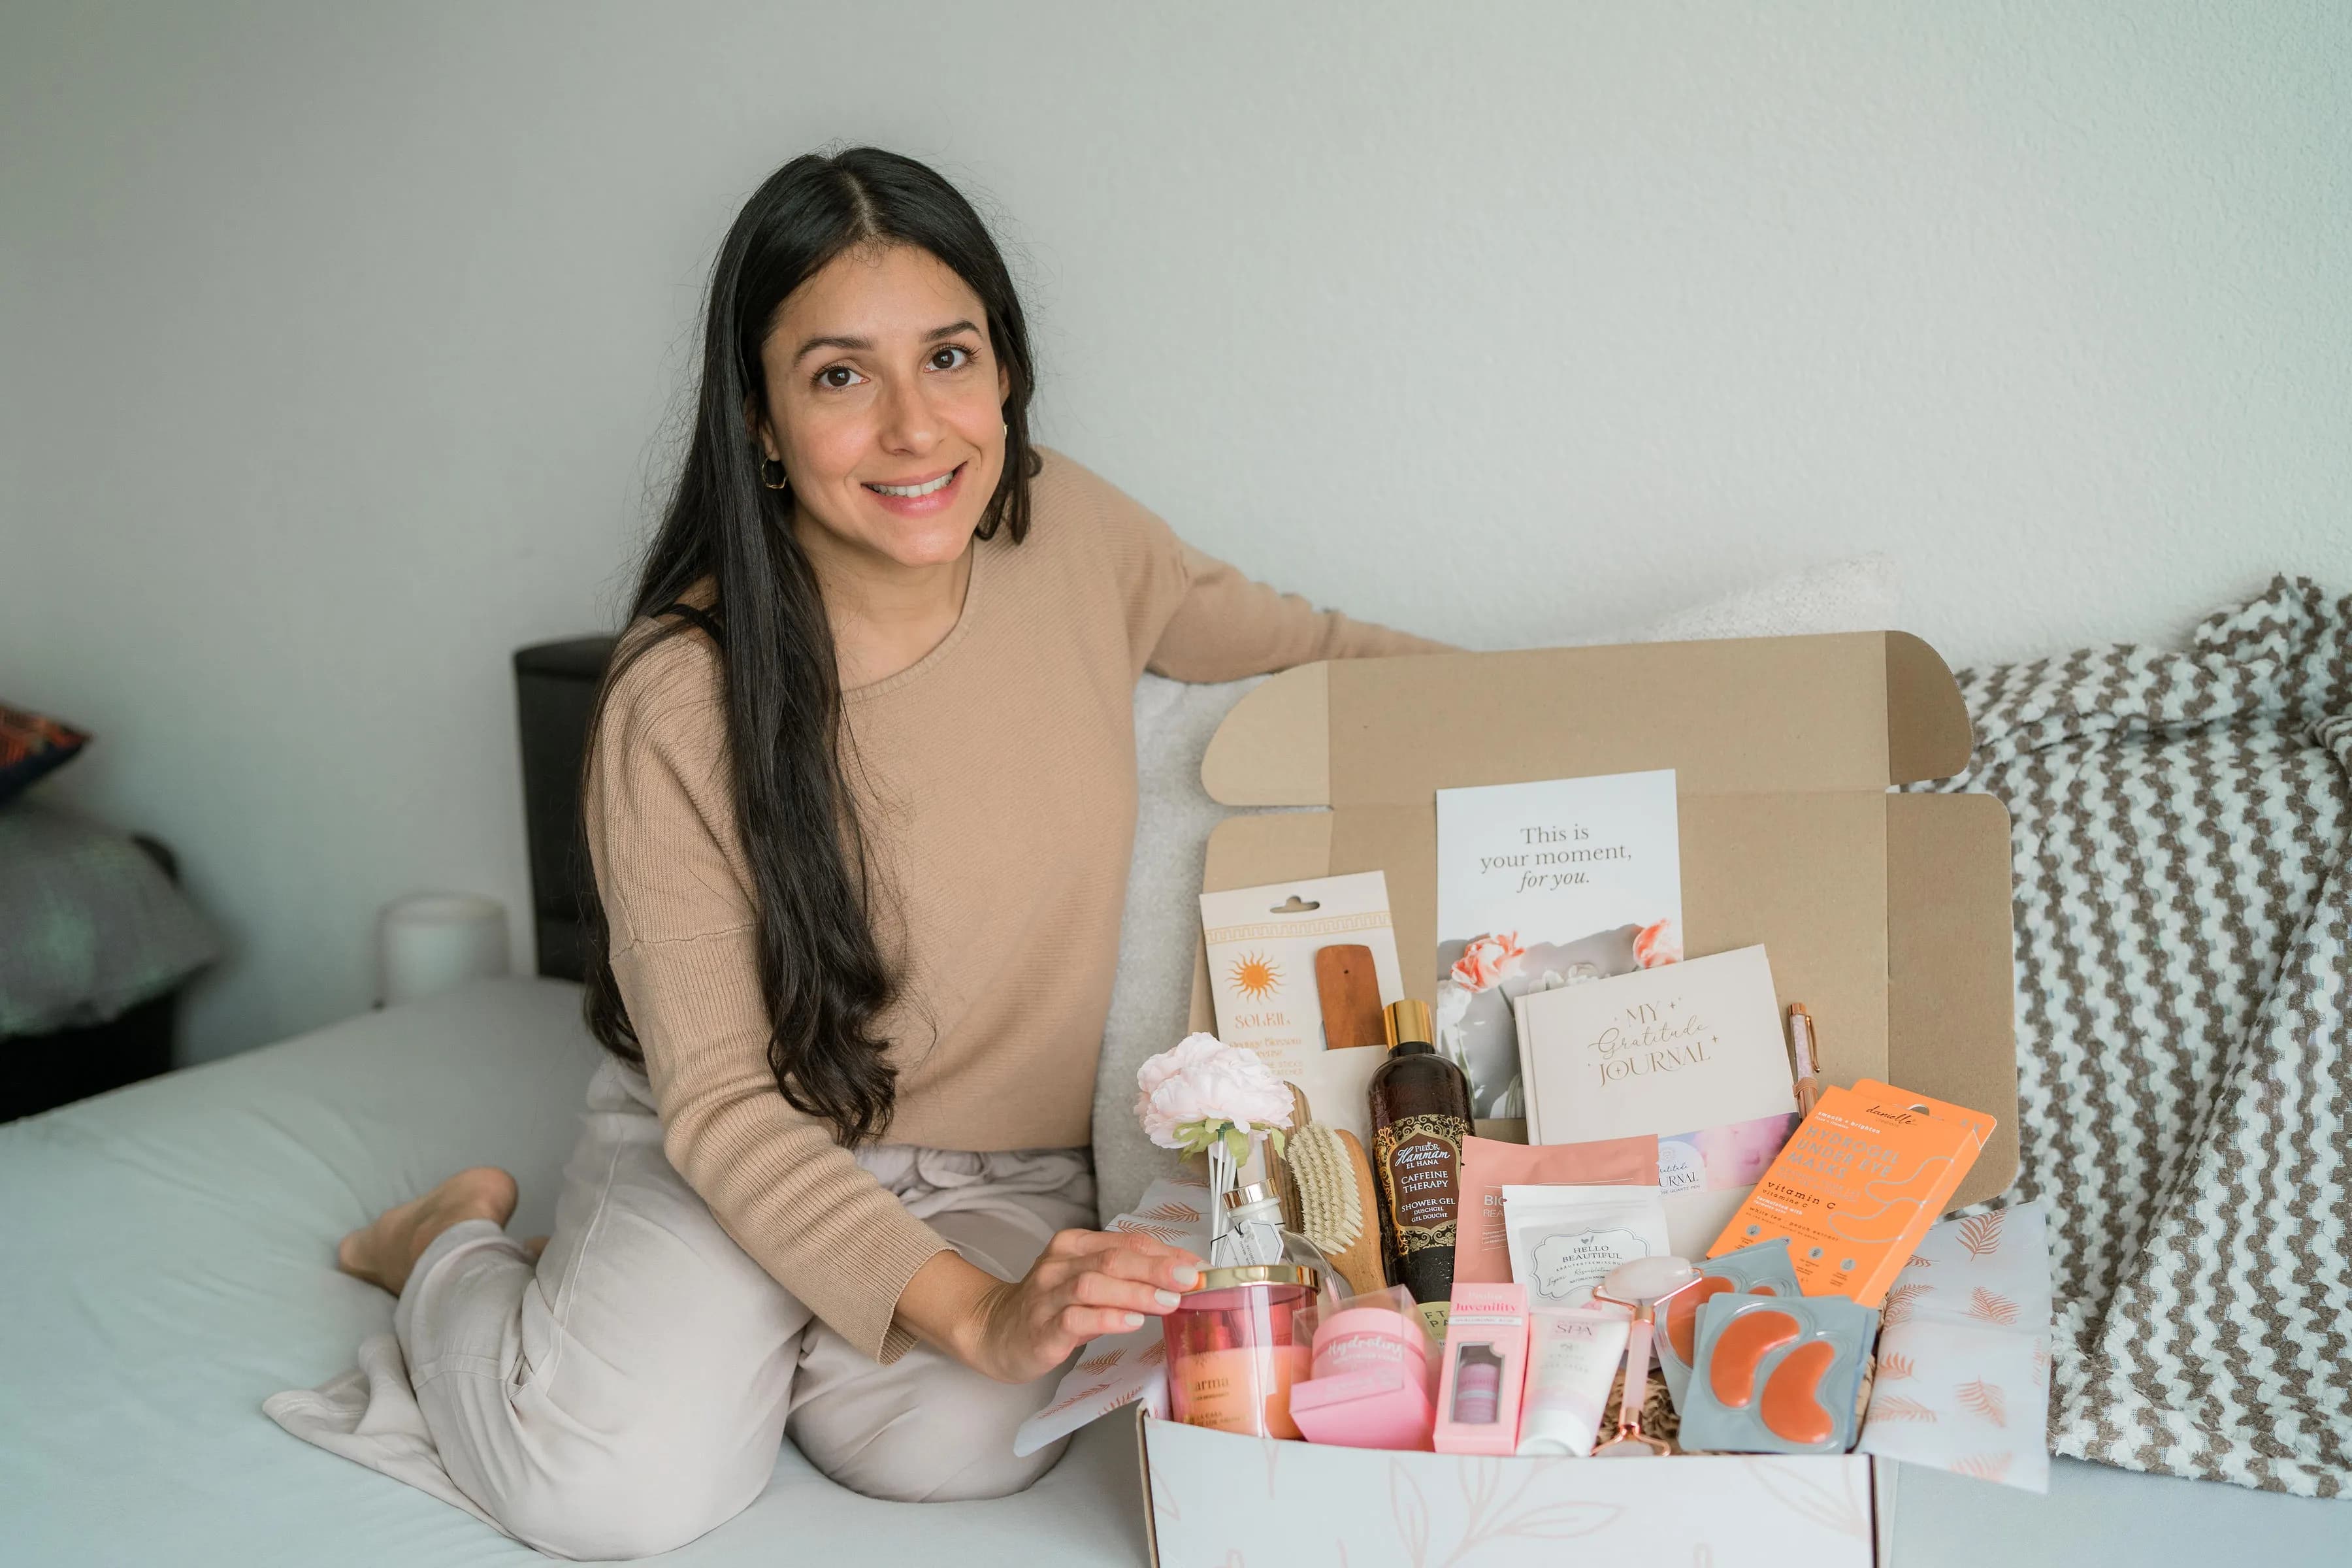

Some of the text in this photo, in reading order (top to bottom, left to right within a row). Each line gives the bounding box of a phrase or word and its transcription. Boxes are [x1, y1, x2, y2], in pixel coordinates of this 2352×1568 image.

[1520, 823, 1590, 844] This is
[1480, 844, 1632, 874] your moment,
[1516, 870, 1590, 893] for you.
[1234, 1012, 1292, 1029] SOLEIL
[1625, 1000, 1661, 1027] MY
[1588, 1015, 1709, 1060] Gratitude
[1600, 1041, 1710, 1088] JOURNAL
[1818, 1111, 1843, 1122] smooth
[1850, 1120, 1882, 1135] brighten
[1866, 1105, 1915, 1125] danielle
[1804, 1124, 1901, 1164] HYDROGEL
[1395, 1146, 1450, 1167] Hammam
[1786, 1151, 1849, 1179] MASKS
[1796, 1137, 1893, 1177] UNDER EYE
[1659, 1161, 1689, 1173] ratitude
[1401, 1171, 1448, 1184] CAFFEINE
[1403, 1180, 1449, 1194] THERAPY
[1659, 1171, 1699, 1187] URNAL
[1763, 1188, 1799, 1205] vitamine
[1768, 1181, 1820, 1205] vitamin
[1401, 1198, 1438, 1212] SHOWER
[1414, 1206, 1445, 1215] DUSCHGEL
[1562, 1252, 1622, 1263] BEAUTIFUL
[1573, 1245, 1609, 1254] HELLO
[1455, 1302, 1516, 1314] Juvenility
[1196, 1377, 1230, 1391] arma
